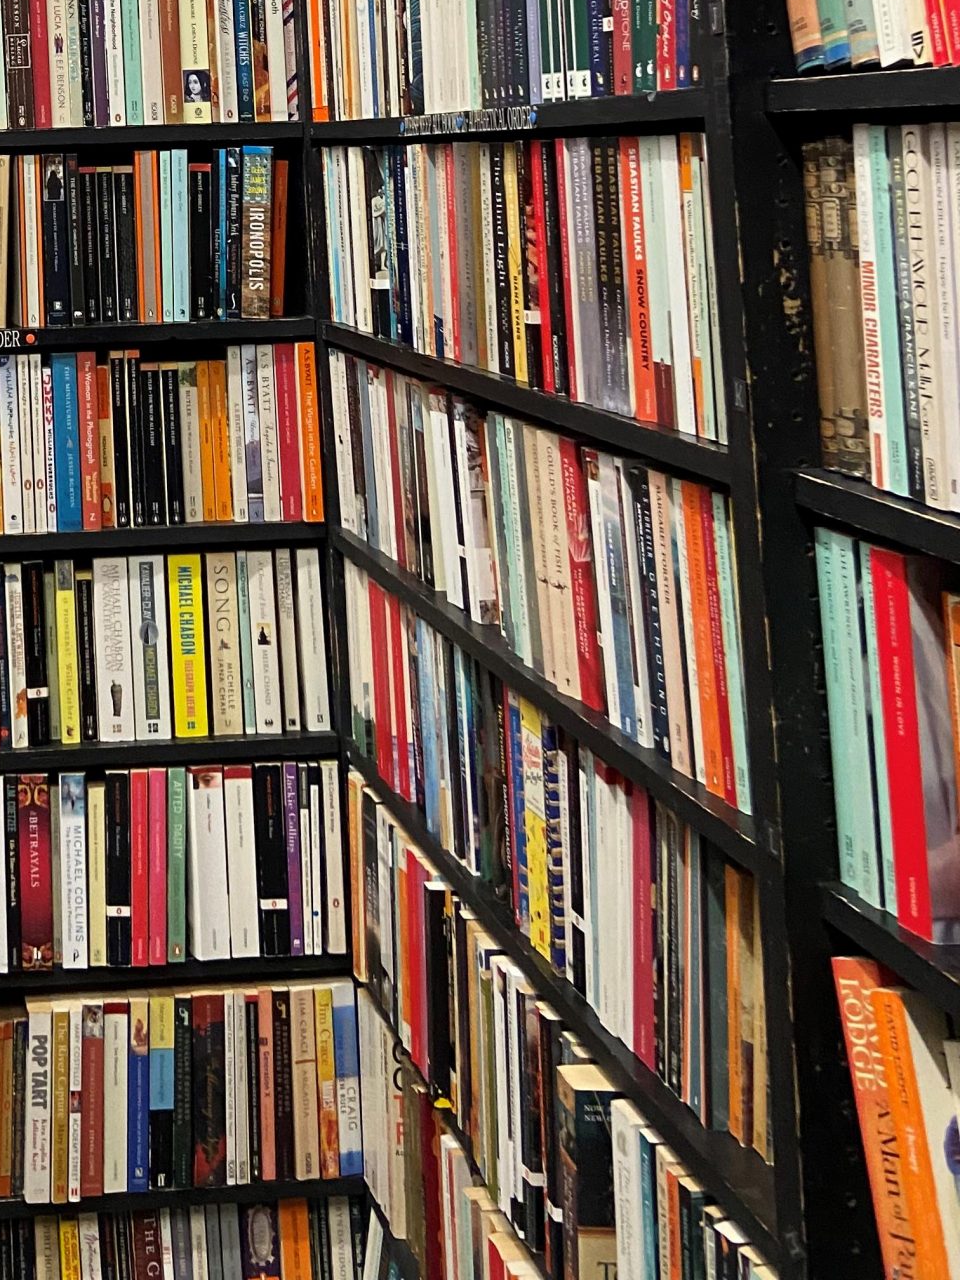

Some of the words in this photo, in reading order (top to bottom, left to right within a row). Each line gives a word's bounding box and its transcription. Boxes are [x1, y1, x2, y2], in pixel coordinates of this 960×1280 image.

[238, 31, 249, 66] WITCHES
[493, 153, 504, 188] The
[628, 148, 640, 213] SEBASTIAN
[494, 192, 506, 238] Blind
[247, 207, 266, 291] IRONOPOLIS
[631, 216, 643, 261] FAULKS
[496, 242, 507, 288] Light
[861, 260, 876, 312] MINOR
[636, 268, 647, 310] SNOW
[638, 312, 649, 370] COUNTRY
[864, 318, 882, 418] CHARACTERS
[177, 566, 193, 608] MICHAEL
[213, 565, 231, 633] SONG
[180, 611, 196, 656] CHABON
[27, 816, 40, 888] BETRAYALS
[31, 1034, 47, 1067] POP
[838, 977, 876, 1091] LODGE
[31, 1070, 49, 1110] TART
